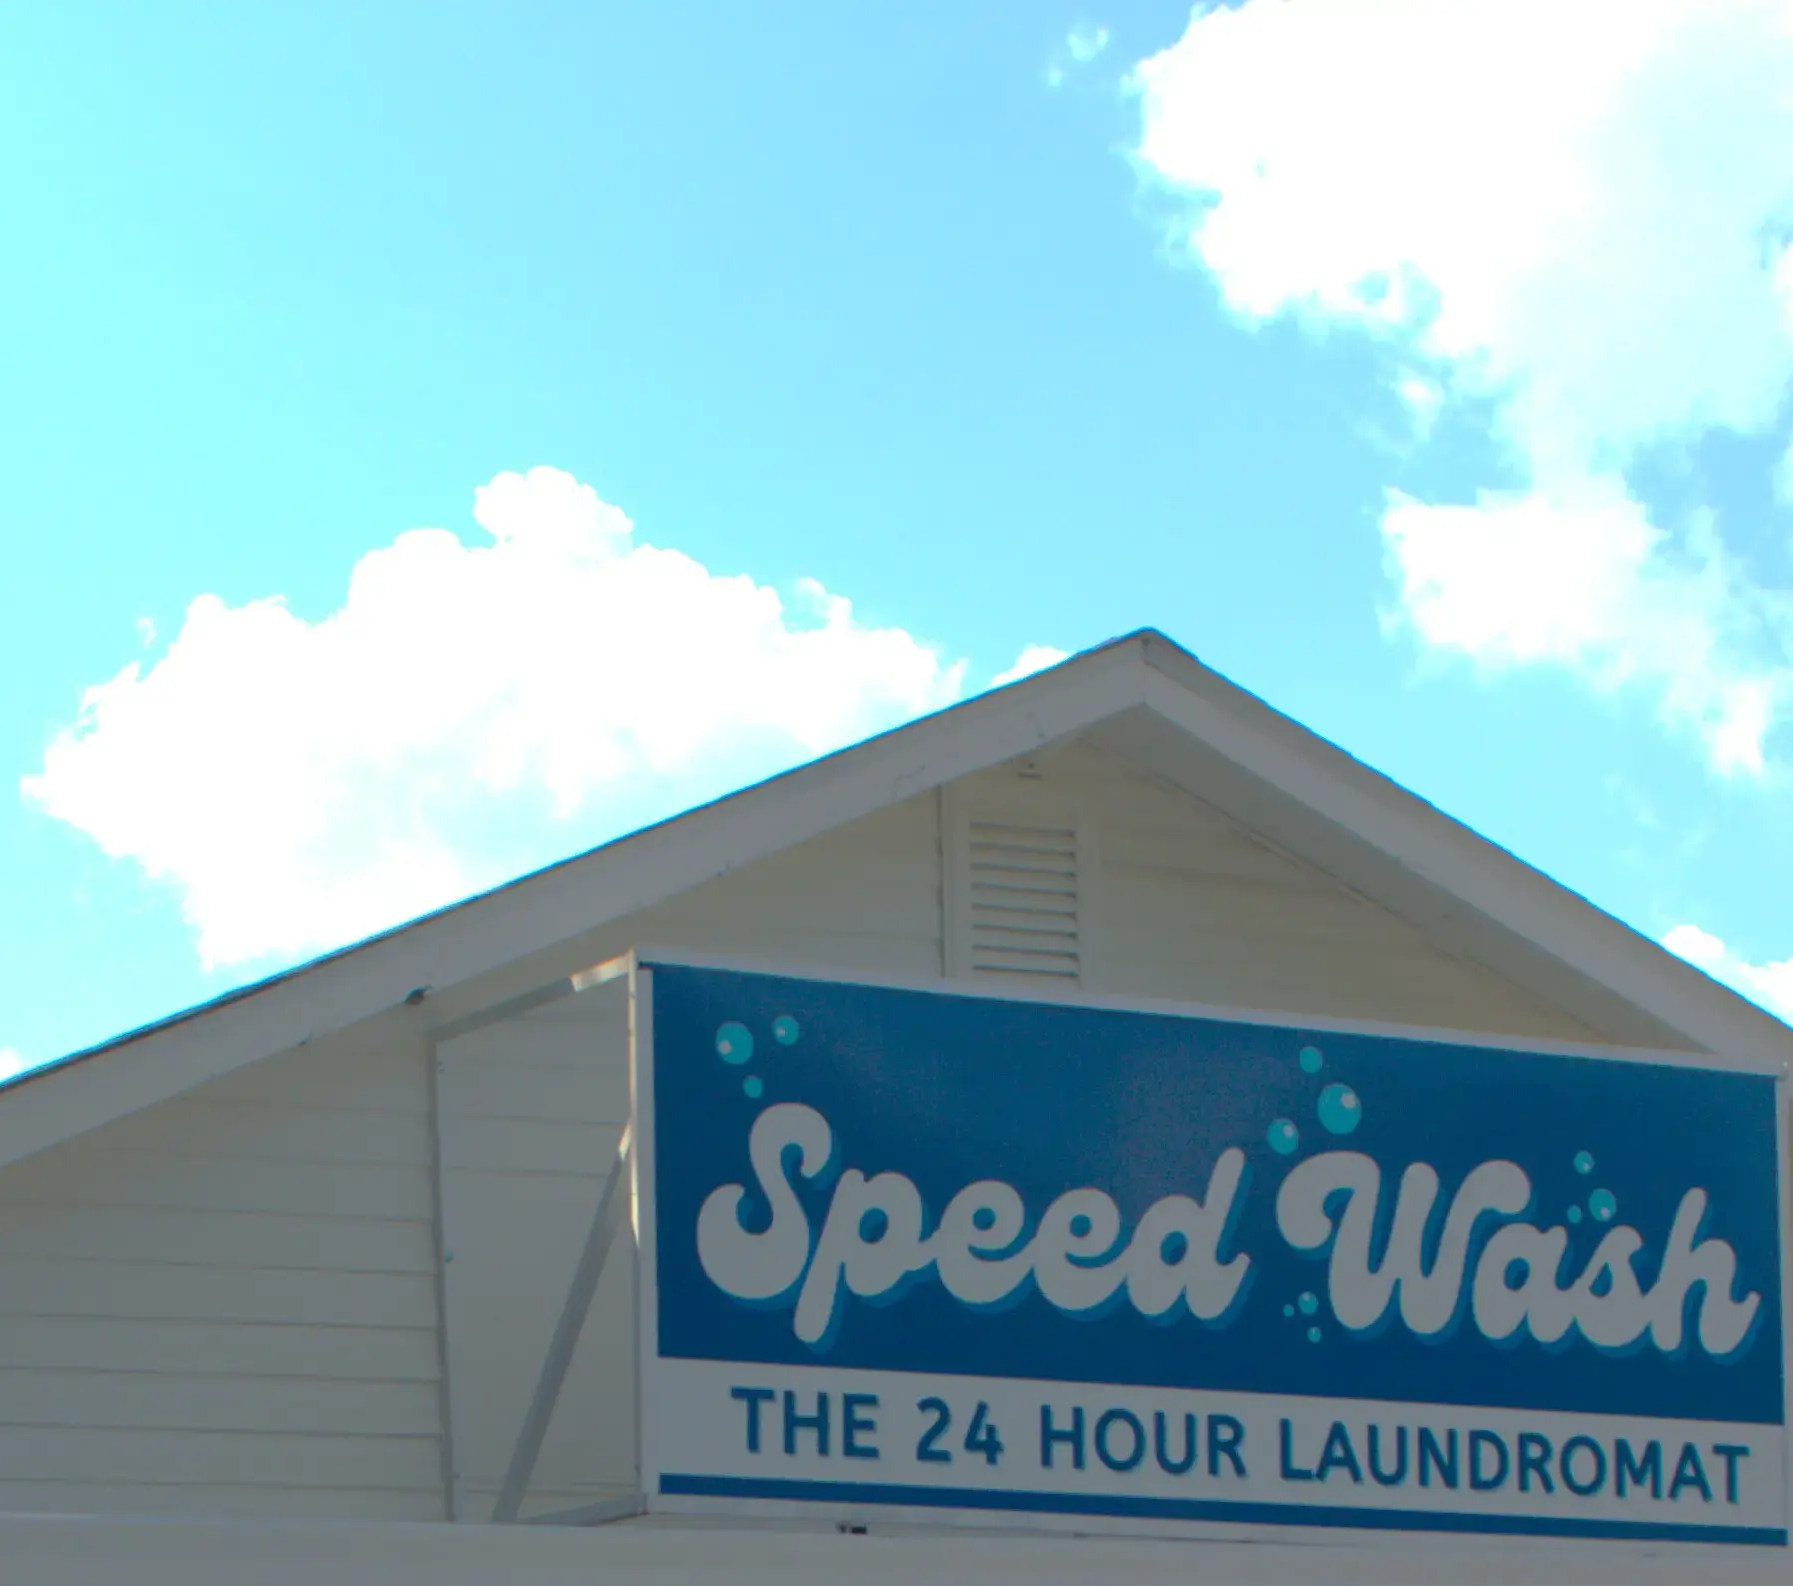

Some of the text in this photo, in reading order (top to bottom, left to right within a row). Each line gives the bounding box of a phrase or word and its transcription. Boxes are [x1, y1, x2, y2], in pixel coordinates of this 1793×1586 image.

[696, 1101, 1763, 1357] Speed Wash
[730, 1384, 1750, 1506] THE 24 HOUR LAUNDROMAT
